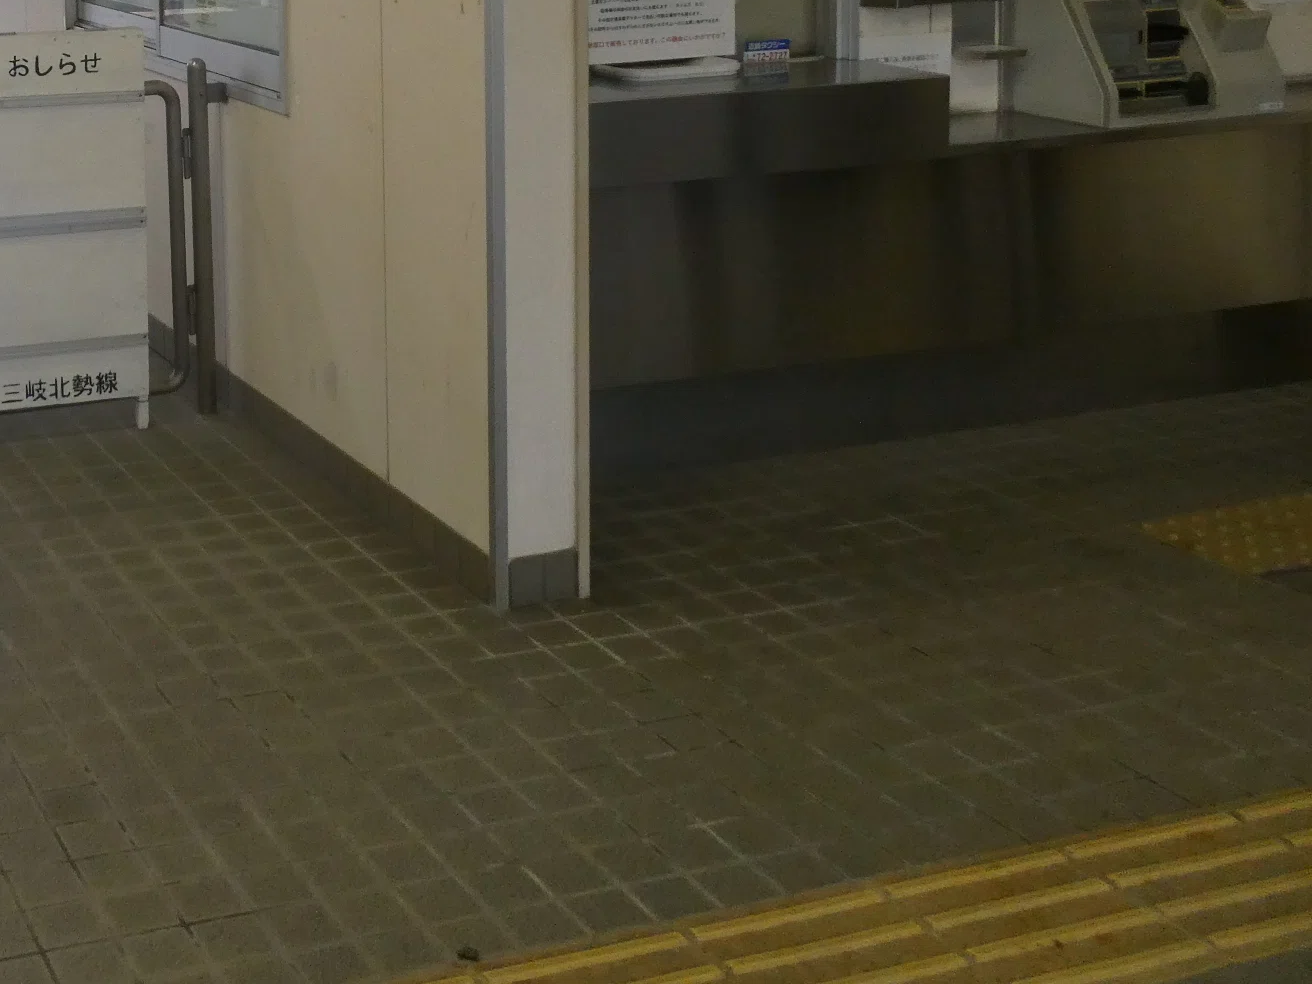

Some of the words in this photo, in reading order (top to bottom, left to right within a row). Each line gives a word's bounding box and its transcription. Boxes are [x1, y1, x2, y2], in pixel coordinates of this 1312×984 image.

[8, 52, 102, 78] おしらせ
[1, 370, 119, 404] 三岐北勢線
